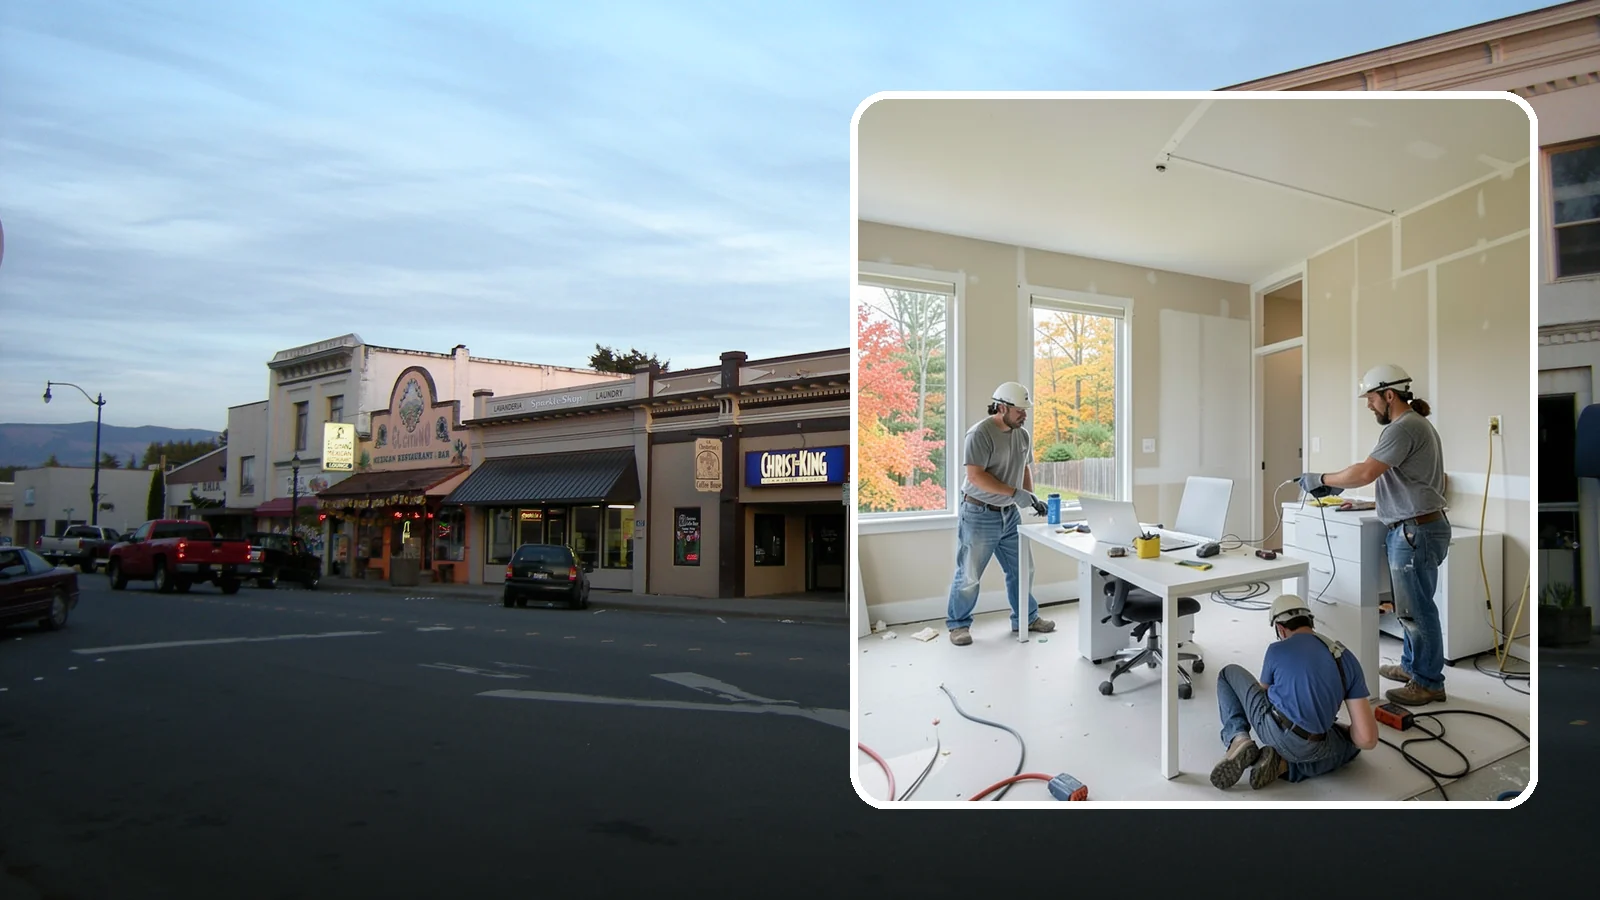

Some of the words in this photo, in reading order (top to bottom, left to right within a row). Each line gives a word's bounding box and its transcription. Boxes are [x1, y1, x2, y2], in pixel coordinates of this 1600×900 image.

[494, 402, 522, 412] LAVANDERIA
[595, 389, 623, 400] LAUNDRY
[374, 455, 396, 464] MEXICAN
[397, 451, 433, 462] RESTAURANT
[437, 450, 450, 459] BAR
[760, 452, 797, 478] CHRIST
[799, 450, 827, 476] KING
